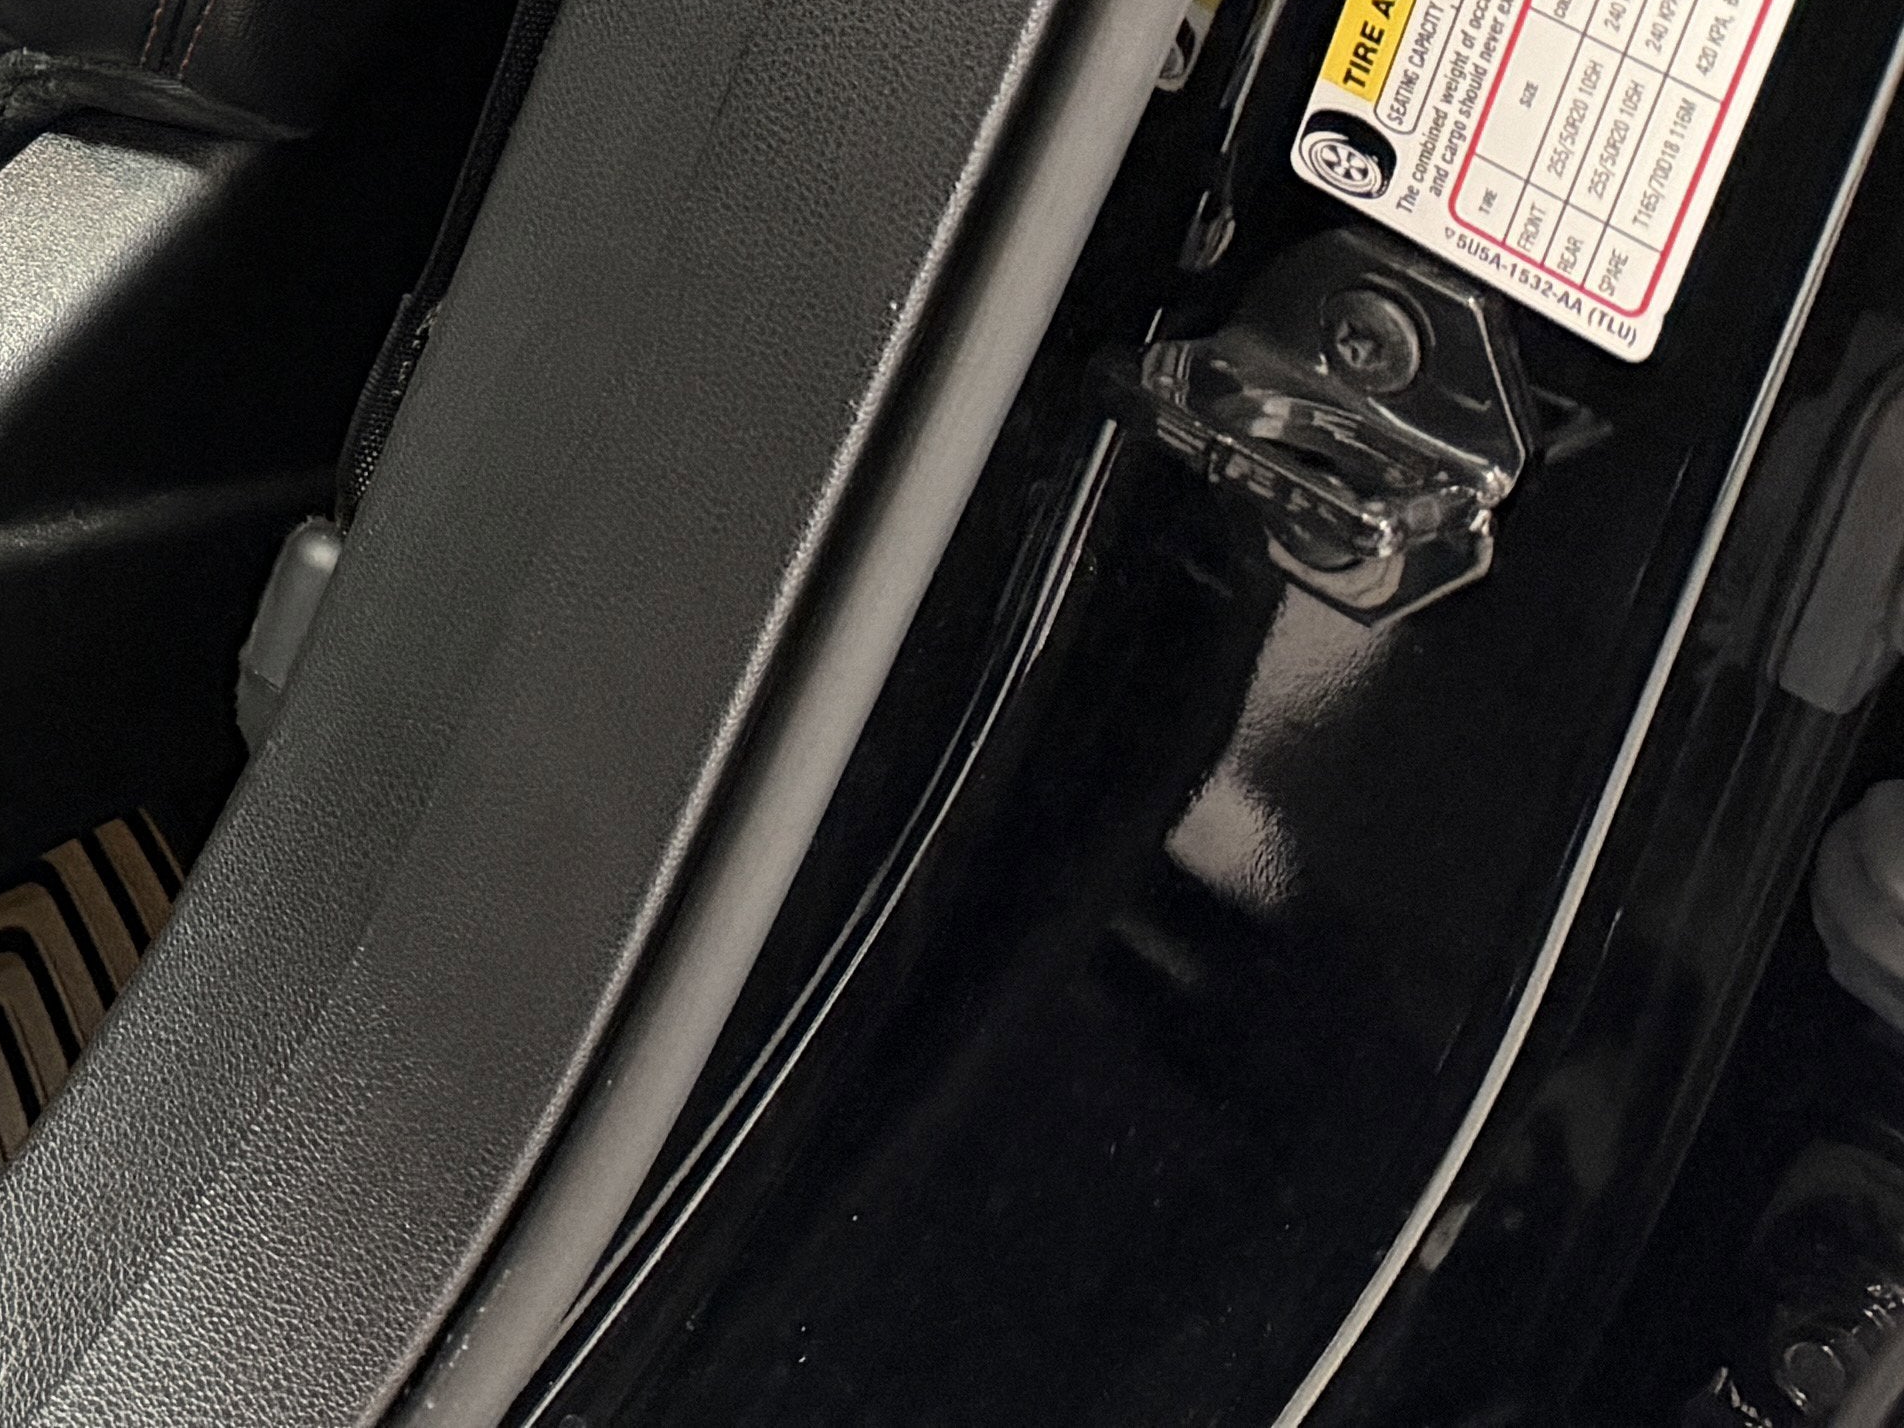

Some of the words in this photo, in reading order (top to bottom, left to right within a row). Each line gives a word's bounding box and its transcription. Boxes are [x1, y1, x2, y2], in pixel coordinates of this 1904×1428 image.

[1601, 0, 1628, 34] 240
[1643, 20, 1670, 54] 240
[1340, 18, 1386, 89] TIRE
[1693, 44, 1719, 77] 420
[1384, 67, 1421, 127] SEATING
[1393, 183, 1421, 214] The
[1409, 103, 1449, 184] combined
[1438, 48, 1471, 106] weight
[1458, 27, 1477, 51] of
[1427, 162, 1451, 199] and
[1439, 118, 1468, 166] cargo
[1456, 60, 1489, 120] should
[1477, 14, 1506, 64] never
[1517, 79, 1540, 110] SIZE
[1544, 96, 1590, 180] 255/50R20
[1576, 57, 1604, 97] 105H
[1585, 117, 1631, 201] 255/50R20
[1617, 77, 1646, 119] 105H
[1629, 137, 1682, 229] T165/70D18
[1667, 95, 1697, 140] 116M
[1476, 186, 1499, 215] TIRE
[1514, 200, 1547, 254] FRONT
[1554, 234, 1584, 275] REAR
[1596, 246, 1630, 298] SPARE
[1585, 305, 1638, 348] (TLU)
